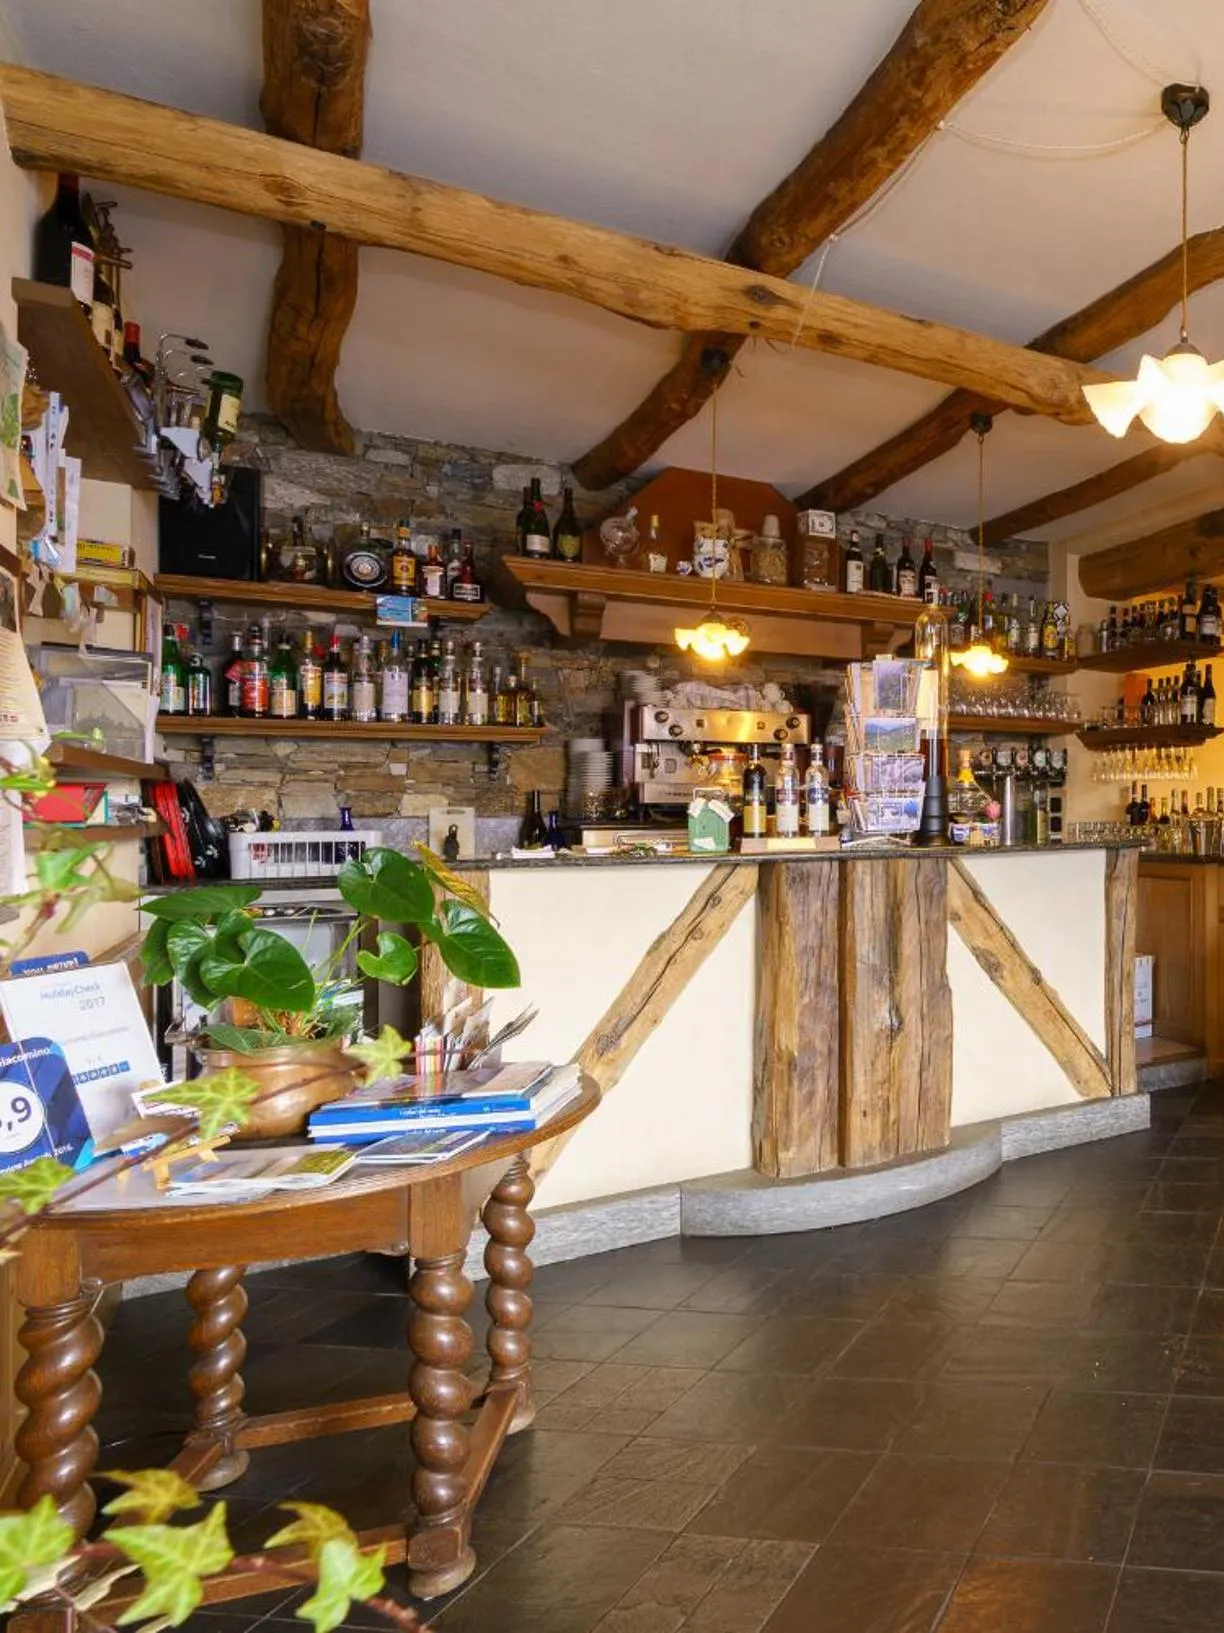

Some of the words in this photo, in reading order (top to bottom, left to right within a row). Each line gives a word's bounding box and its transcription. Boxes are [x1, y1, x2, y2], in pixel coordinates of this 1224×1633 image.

[40, 983, 101, 1000] HolidayCheck
[79, 996, 106, 1010] 2017
[0, 1049, 51, 1066] iacomino
[0, 1096, 32, 1131] ,9
